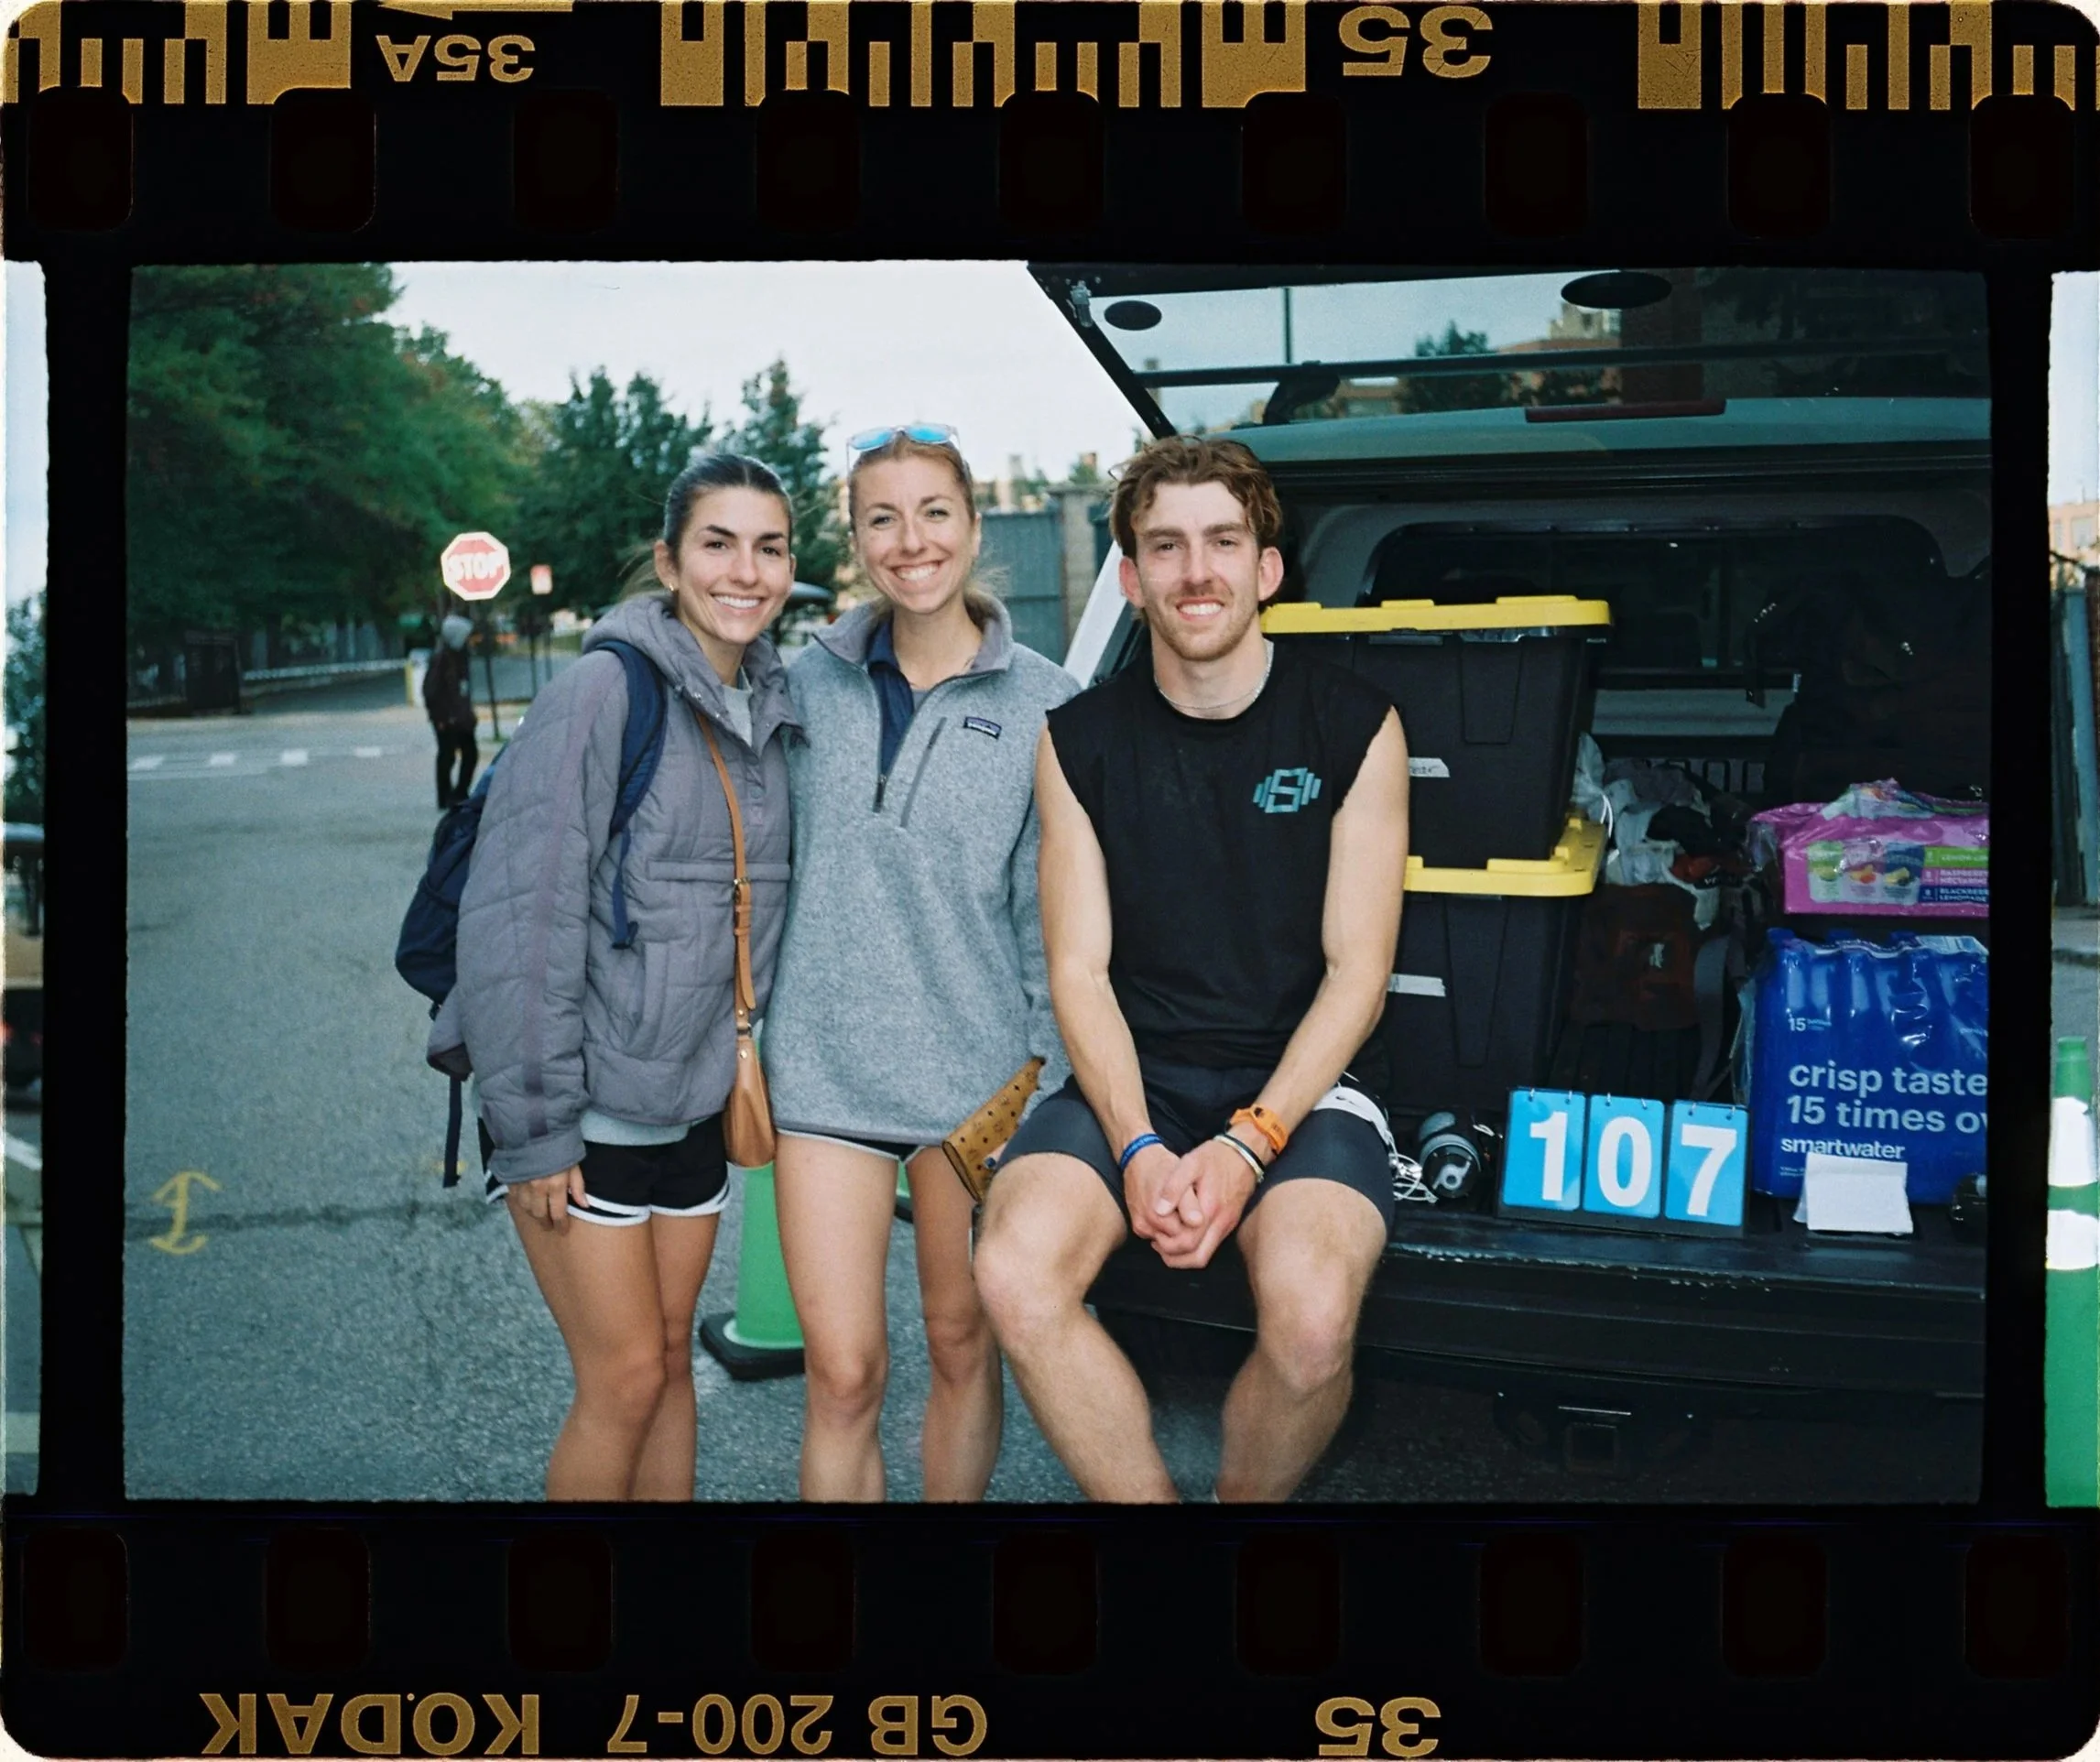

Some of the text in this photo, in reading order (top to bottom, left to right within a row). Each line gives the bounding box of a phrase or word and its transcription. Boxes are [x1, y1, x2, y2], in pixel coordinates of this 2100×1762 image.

[375, 35, 535, 82] 35A
[1339, 5, 1493, 78] 35
[449, 551, 503, 581] STOP
[1788, 1017, 1806, 1031] 15
[1789, 1060, 1987, 1098] crisp taste
[1787, 1095, 1826, 1125] 15
[1836, 1099, 1947, 1132] times
[1530, 1111, 1736, 1217] 107
[1780, 1137, 1906, 1159] smartwater
[606, 1693, 834, 1756] 200-7
[868, 1694, 988, 1757] GB
[1314, 1696, 1445, 1758] 35
